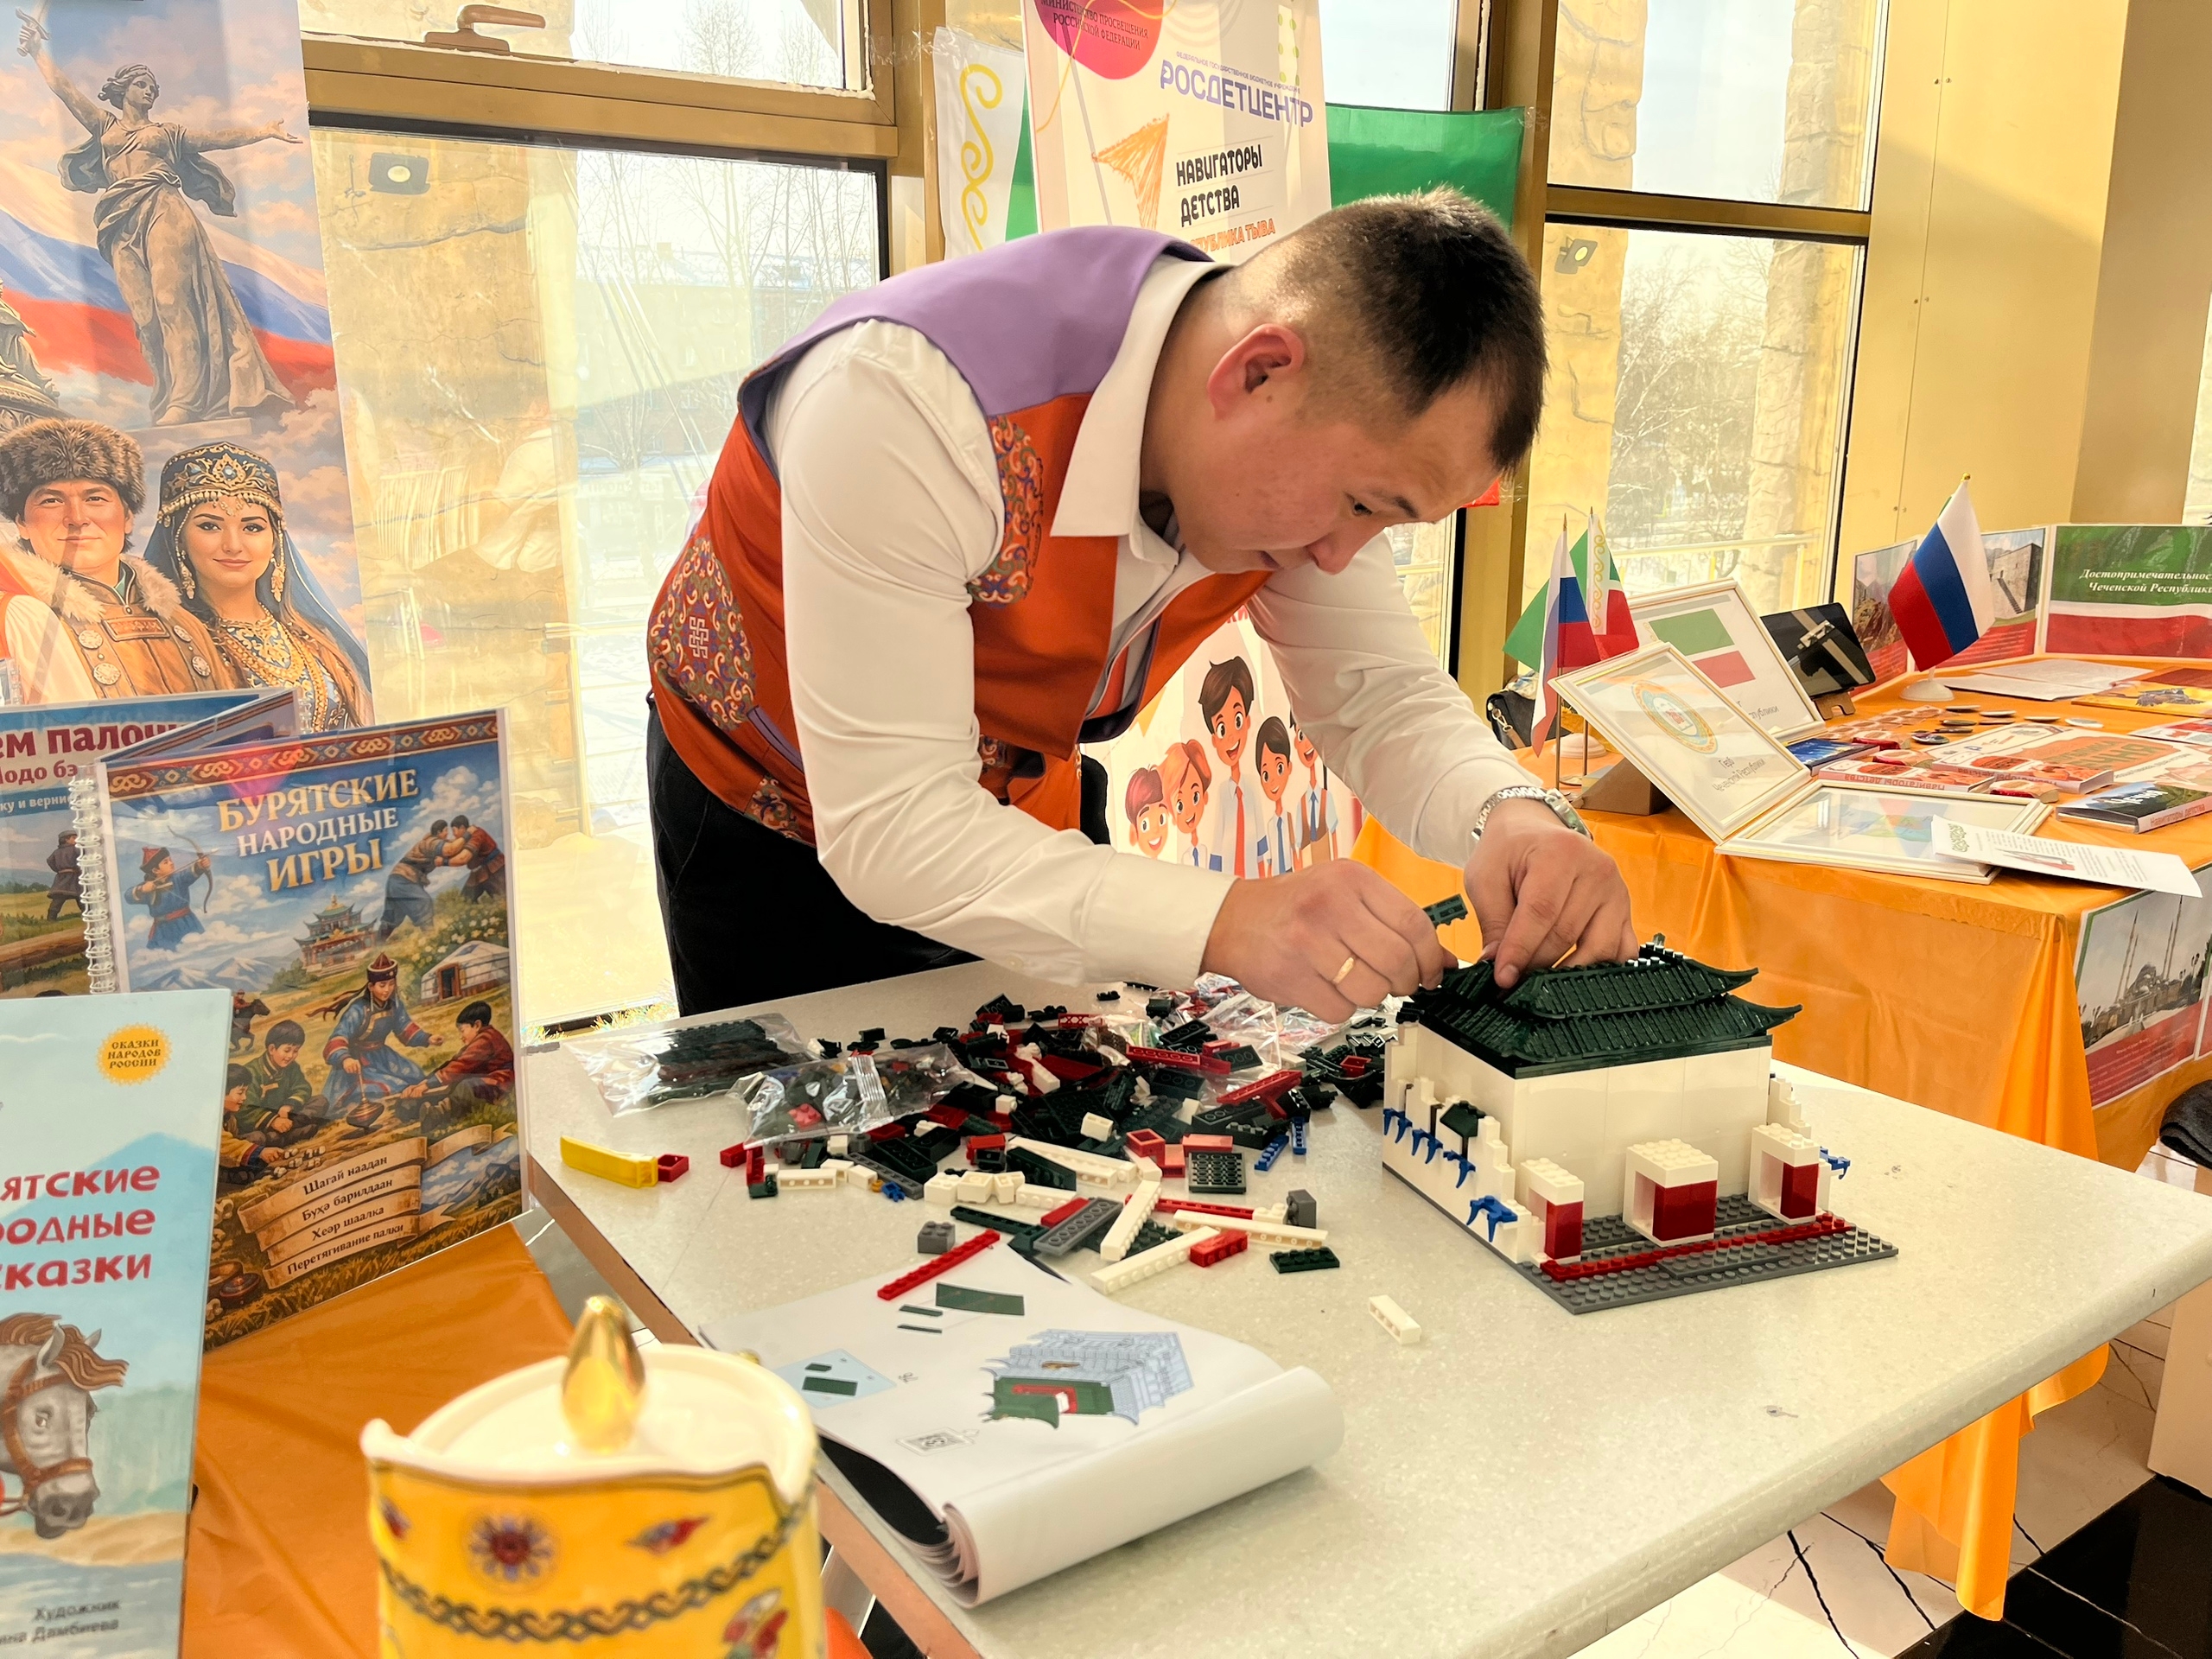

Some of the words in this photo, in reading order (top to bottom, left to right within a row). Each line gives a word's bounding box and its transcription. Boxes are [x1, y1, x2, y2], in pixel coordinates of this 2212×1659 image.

[1053, 12, 1099, 37] РОССИЙСКОЙ
[1100, 29, 1141, 50] ФЕДЕРАЦИИ
[1099, 13, 1148, 39] ПРОСВЕЩЕНИЯ
[1160, 60, 1313, 127] РОСДЕТЦЕНТР
[1176, 143, 1262, 187] НАВИГАТОРЫ
[1180, 185, 1240, 227] ДЕТСТВА
[1245, 218, 1276, 241] ТЫВА
[2088, 582, 2147, 593] Чеченской
[0, 766, 48, 785] одо
[18, 799, 26, 809] и
[216, 768, 419, 833] БУРЯТСКИЕ
[236, 807, 399, 857] НАРОДНЫЕ
[266, 838, 383, 892] ИГРЫ
[107, 1049, 162, 1059] НАРОДОВ
[111, 1039, 159, 1050] СКАЗКИ
[109, 1058, 157, 1069] РОССИИ
[0, 1166, 161, 1201] ятские
[302, 1170, 345, 1196] Шагай
[347, 1156, 387, 1177] наадан
[334, 1179, 393, 1206] барилдаан
[0, 1209, 156, 1245] одные
[287, 1234, 371, 1274] Перетягивание
[373, 1224, 404, 1239] палки
[0, 1254, 152, 1290] казки
[33, 1600, 120, 1622] Художник
